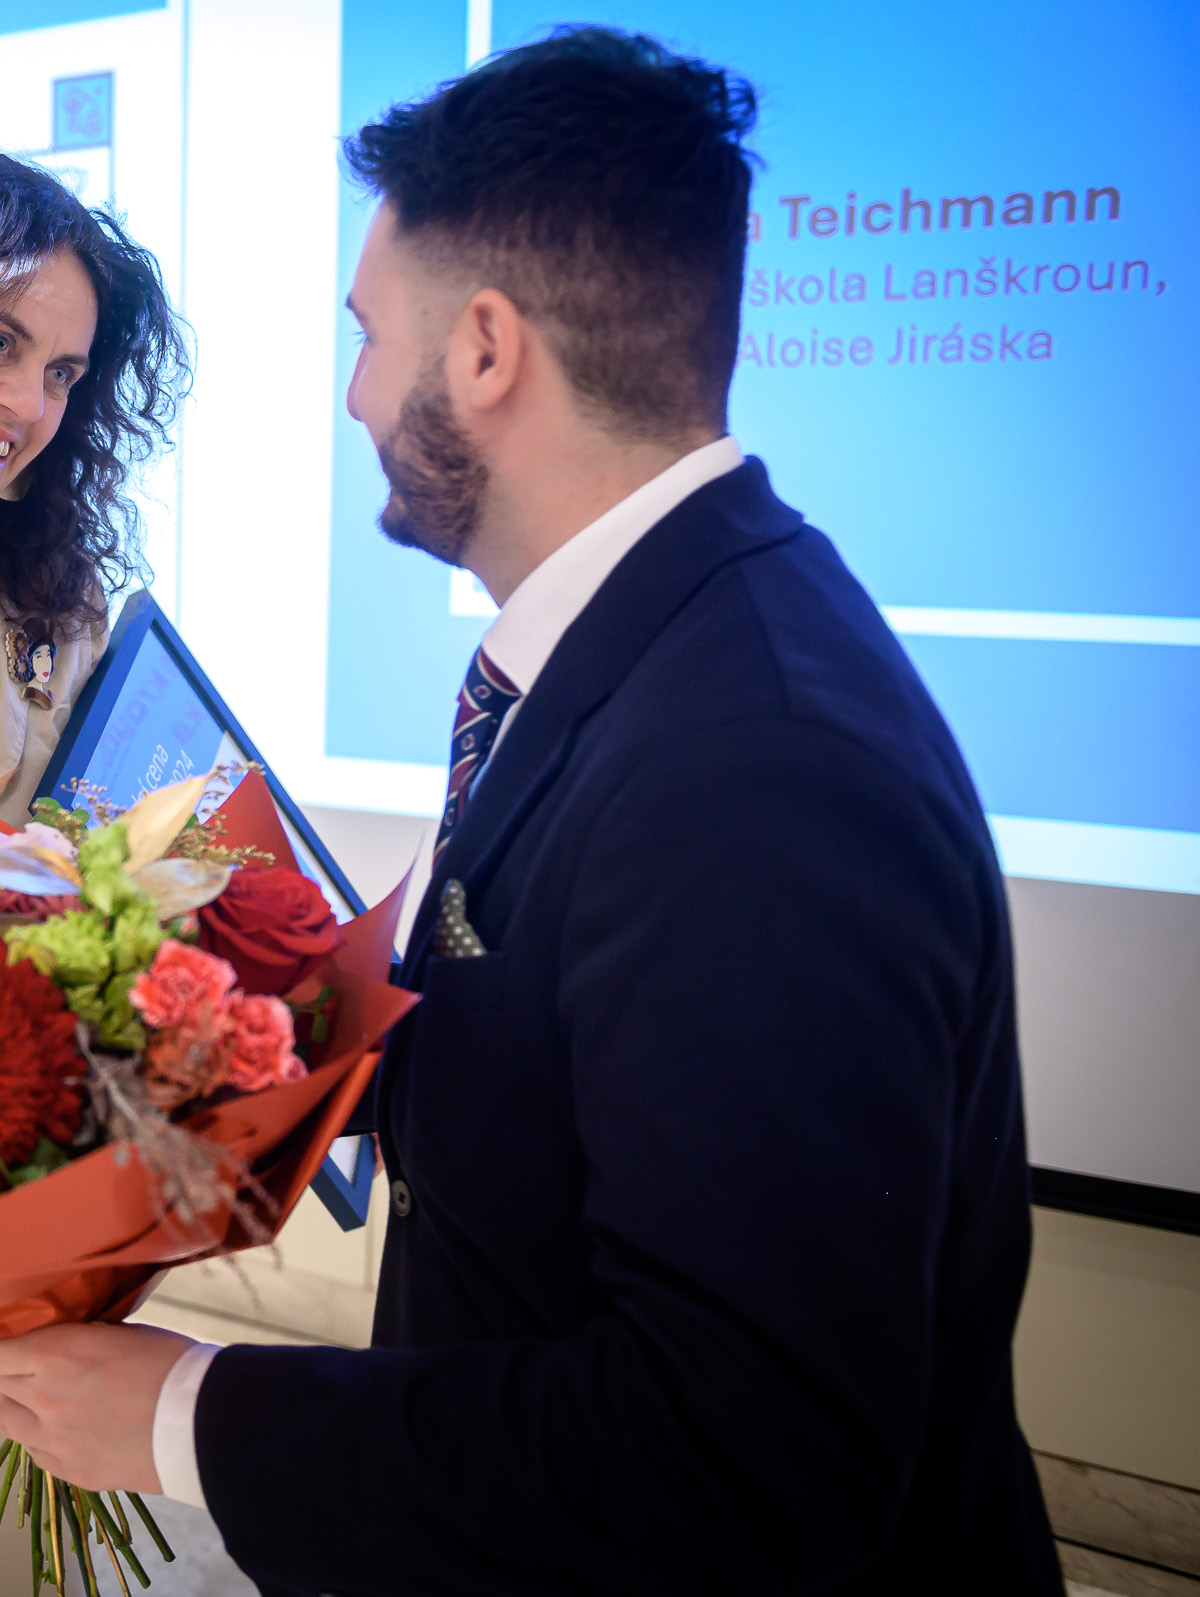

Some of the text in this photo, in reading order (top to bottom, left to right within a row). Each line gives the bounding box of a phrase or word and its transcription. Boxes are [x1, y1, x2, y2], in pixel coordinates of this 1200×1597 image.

[779, 184, 1122, 241] Teichmann
[748, 255, 1168, 308] škola Lanškroun,
[738, 322, 1054, 369] Aloise Jiráska
[145, 743, 170, 790] cena
